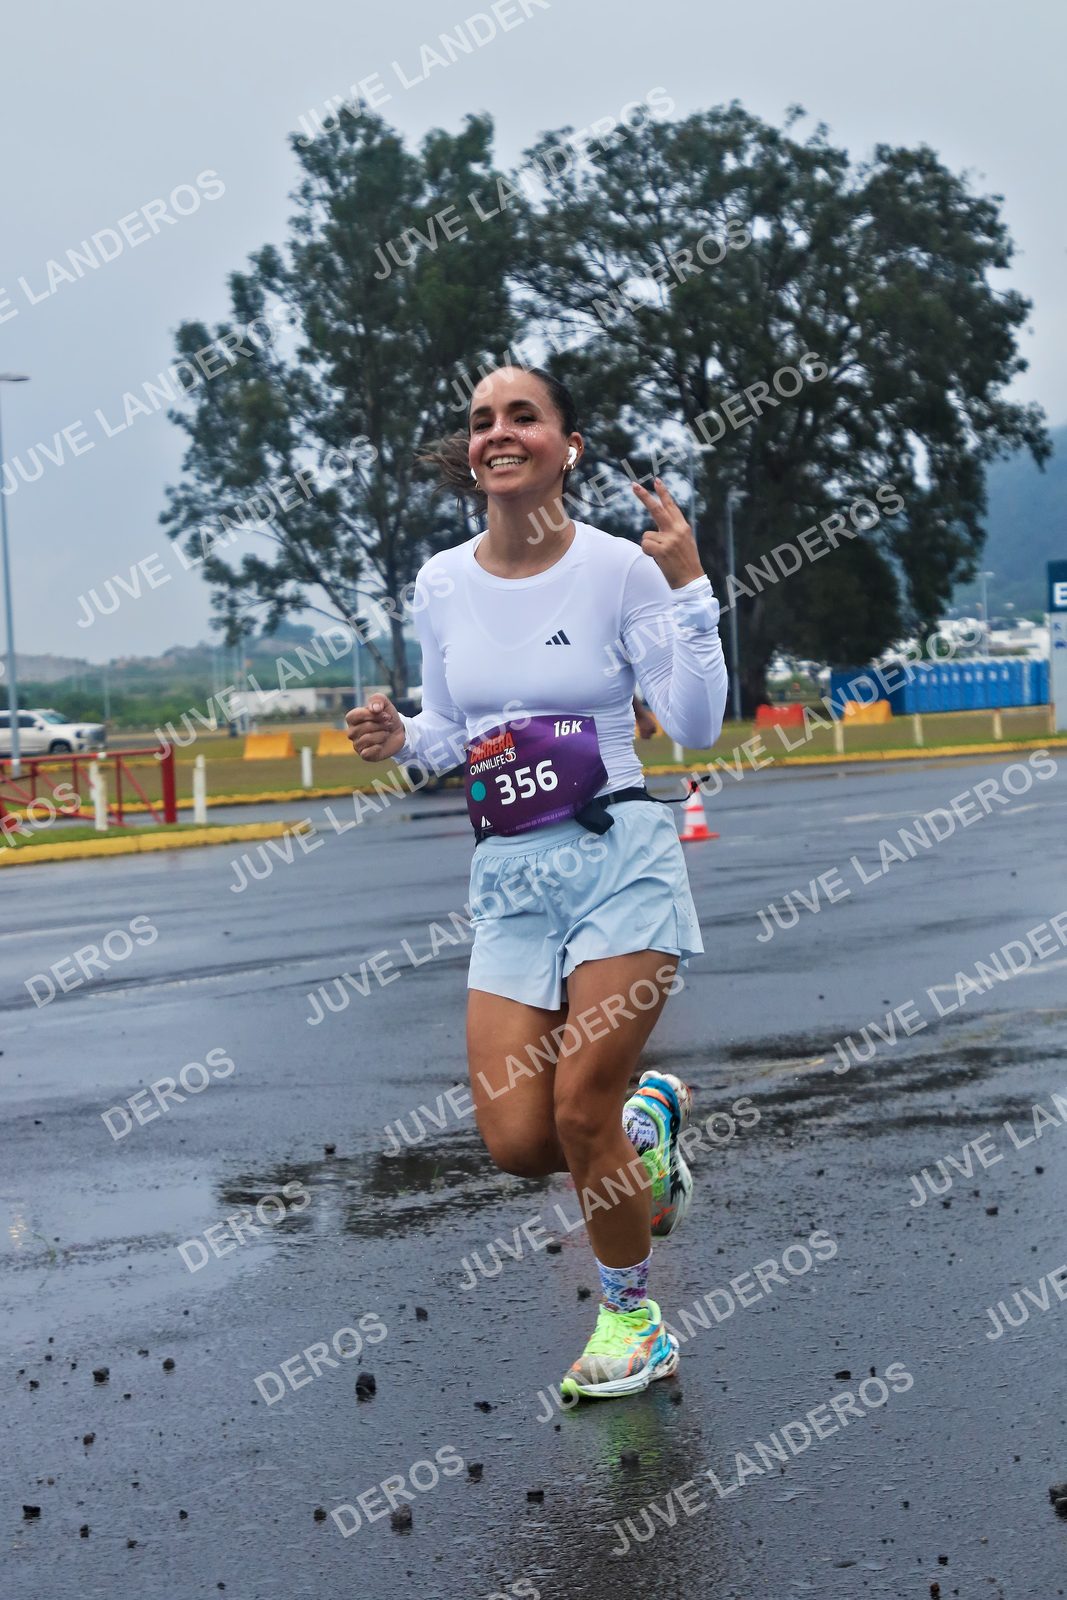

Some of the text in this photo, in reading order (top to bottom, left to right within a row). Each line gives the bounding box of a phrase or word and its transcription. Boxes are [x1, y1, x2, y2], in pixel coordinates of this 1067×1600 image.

[470, 732, 514, 765] CARRERA
[470, 753, 506, 775] OMNILIFE
[495, 759, 559, 806] 356
